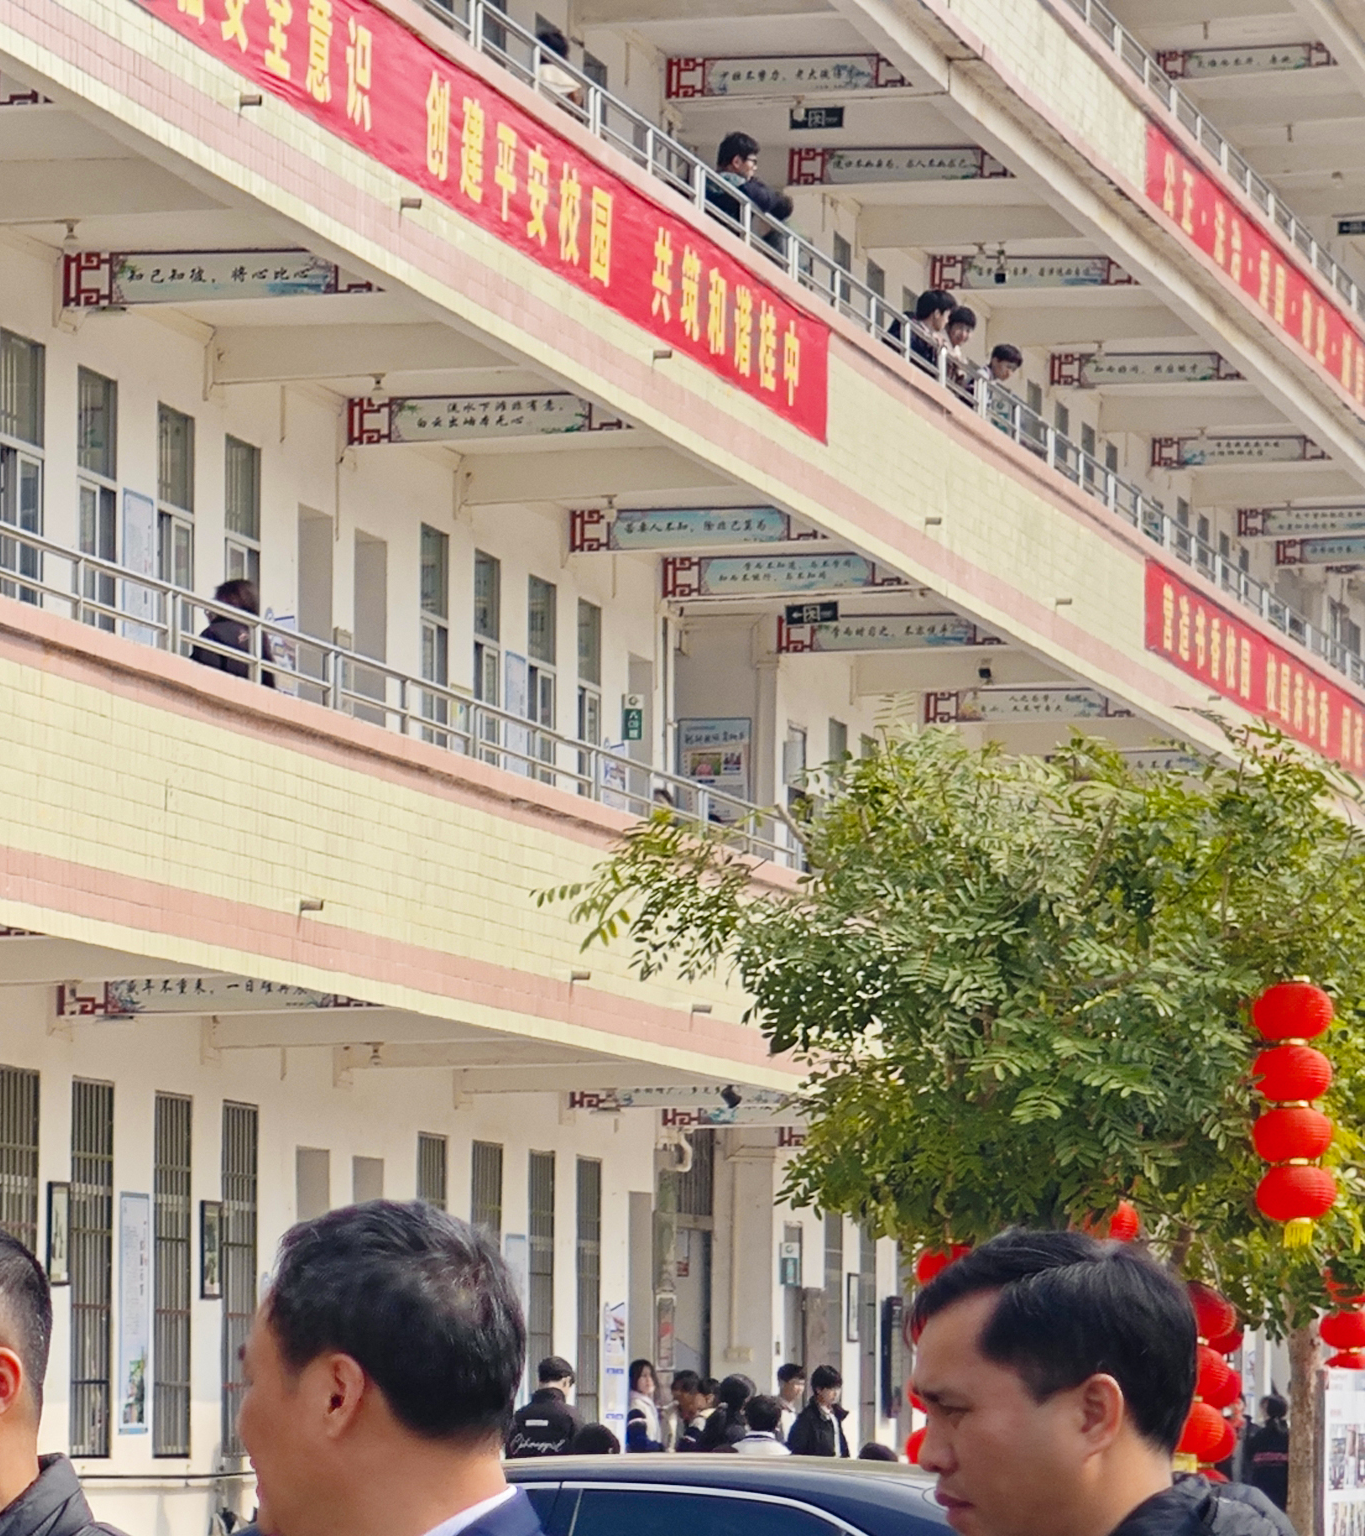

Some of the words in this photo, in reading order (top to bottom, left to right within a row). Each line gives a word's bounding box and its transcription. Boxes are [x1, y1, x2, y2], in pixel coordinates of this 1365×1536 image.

[177, 0, 373, 133] 全意识
[425, 70, 613, 288] 创建平安校园
[652, 228, 802, 407] 共筑和谐桂中
